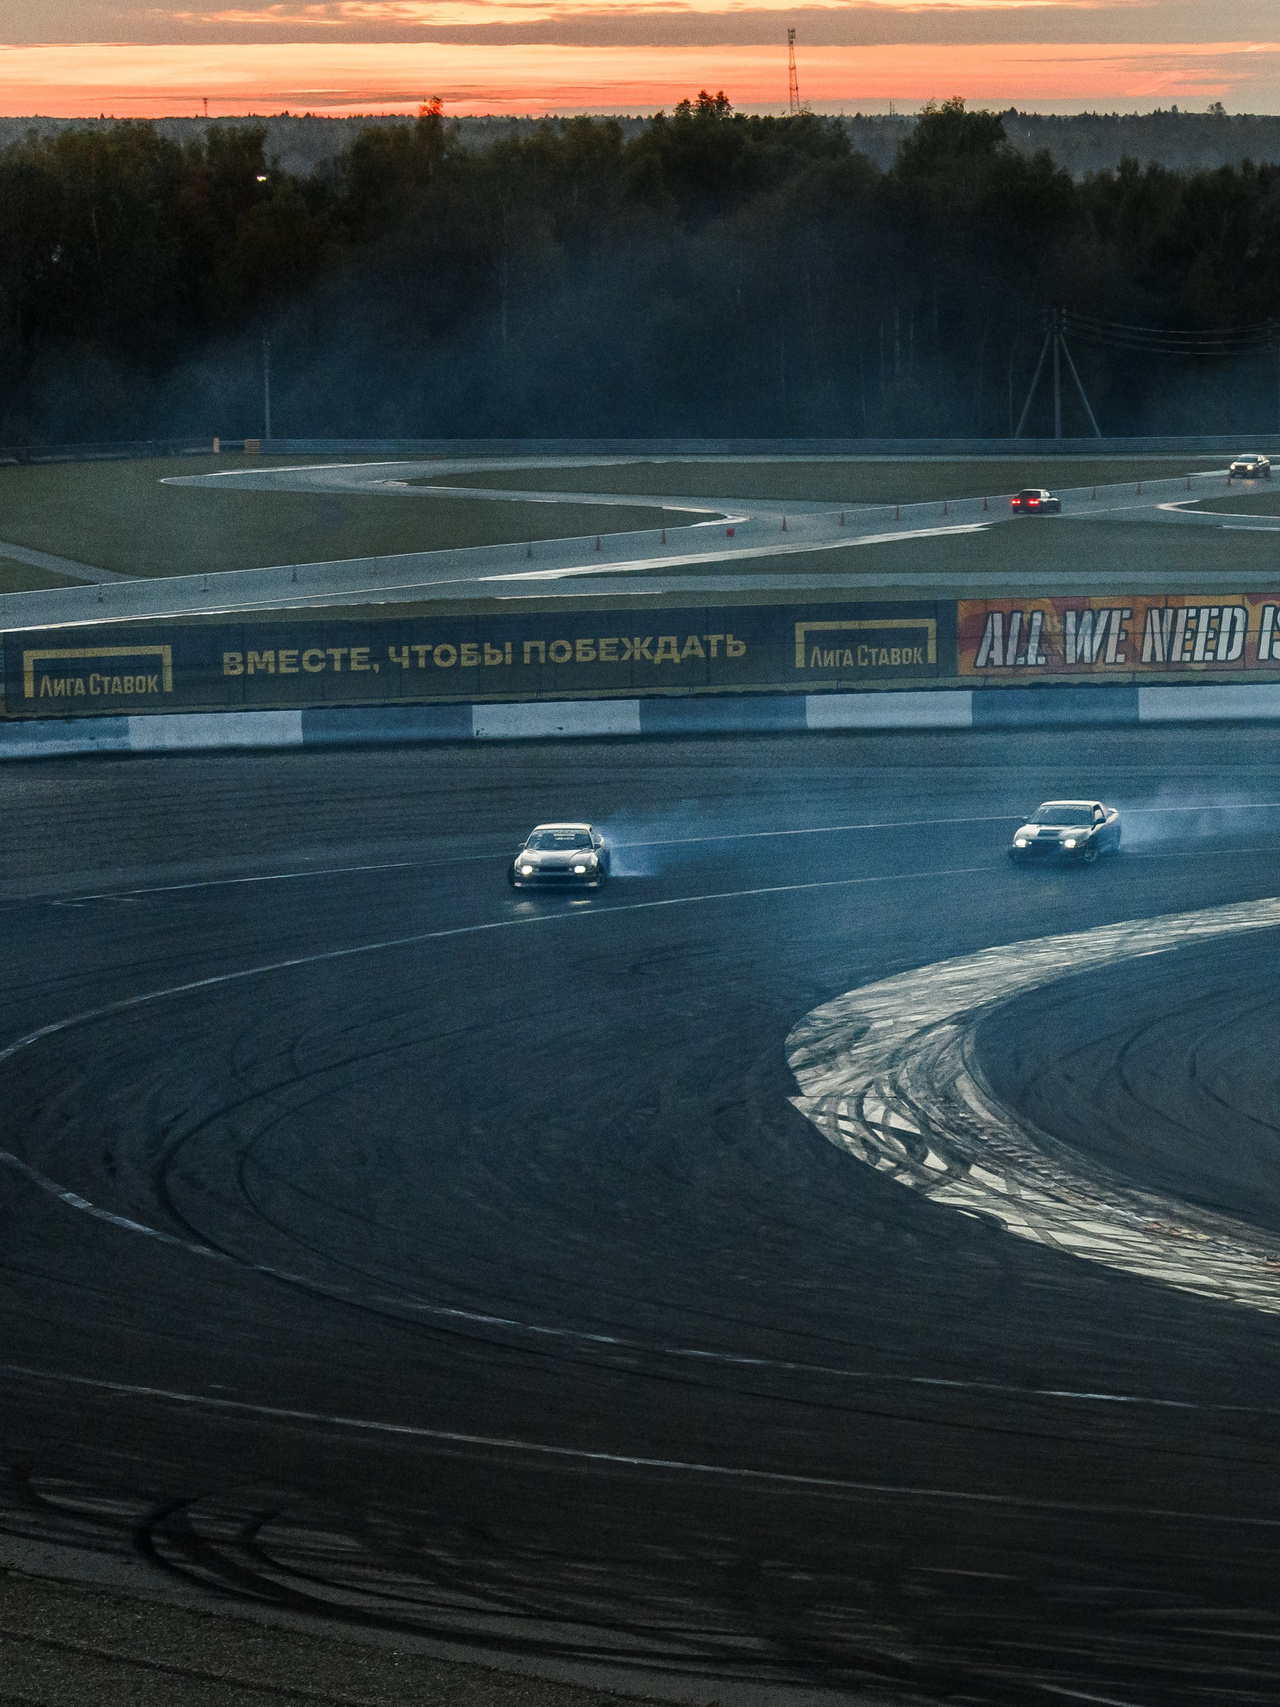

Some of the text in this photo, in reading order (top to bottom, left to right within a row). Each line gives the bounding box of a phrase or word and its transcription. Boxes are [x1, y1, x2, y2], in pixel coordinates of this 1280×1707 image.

[222, 633, 747, 676] ВМЕСТЕ, ЧТОБЫ ПОБЕЖДАТЬ
[974, 610, 1047, 668] ALL
[1064, 608, 1133, 665] WE
[1140, 606, 1247, 663] NEED
